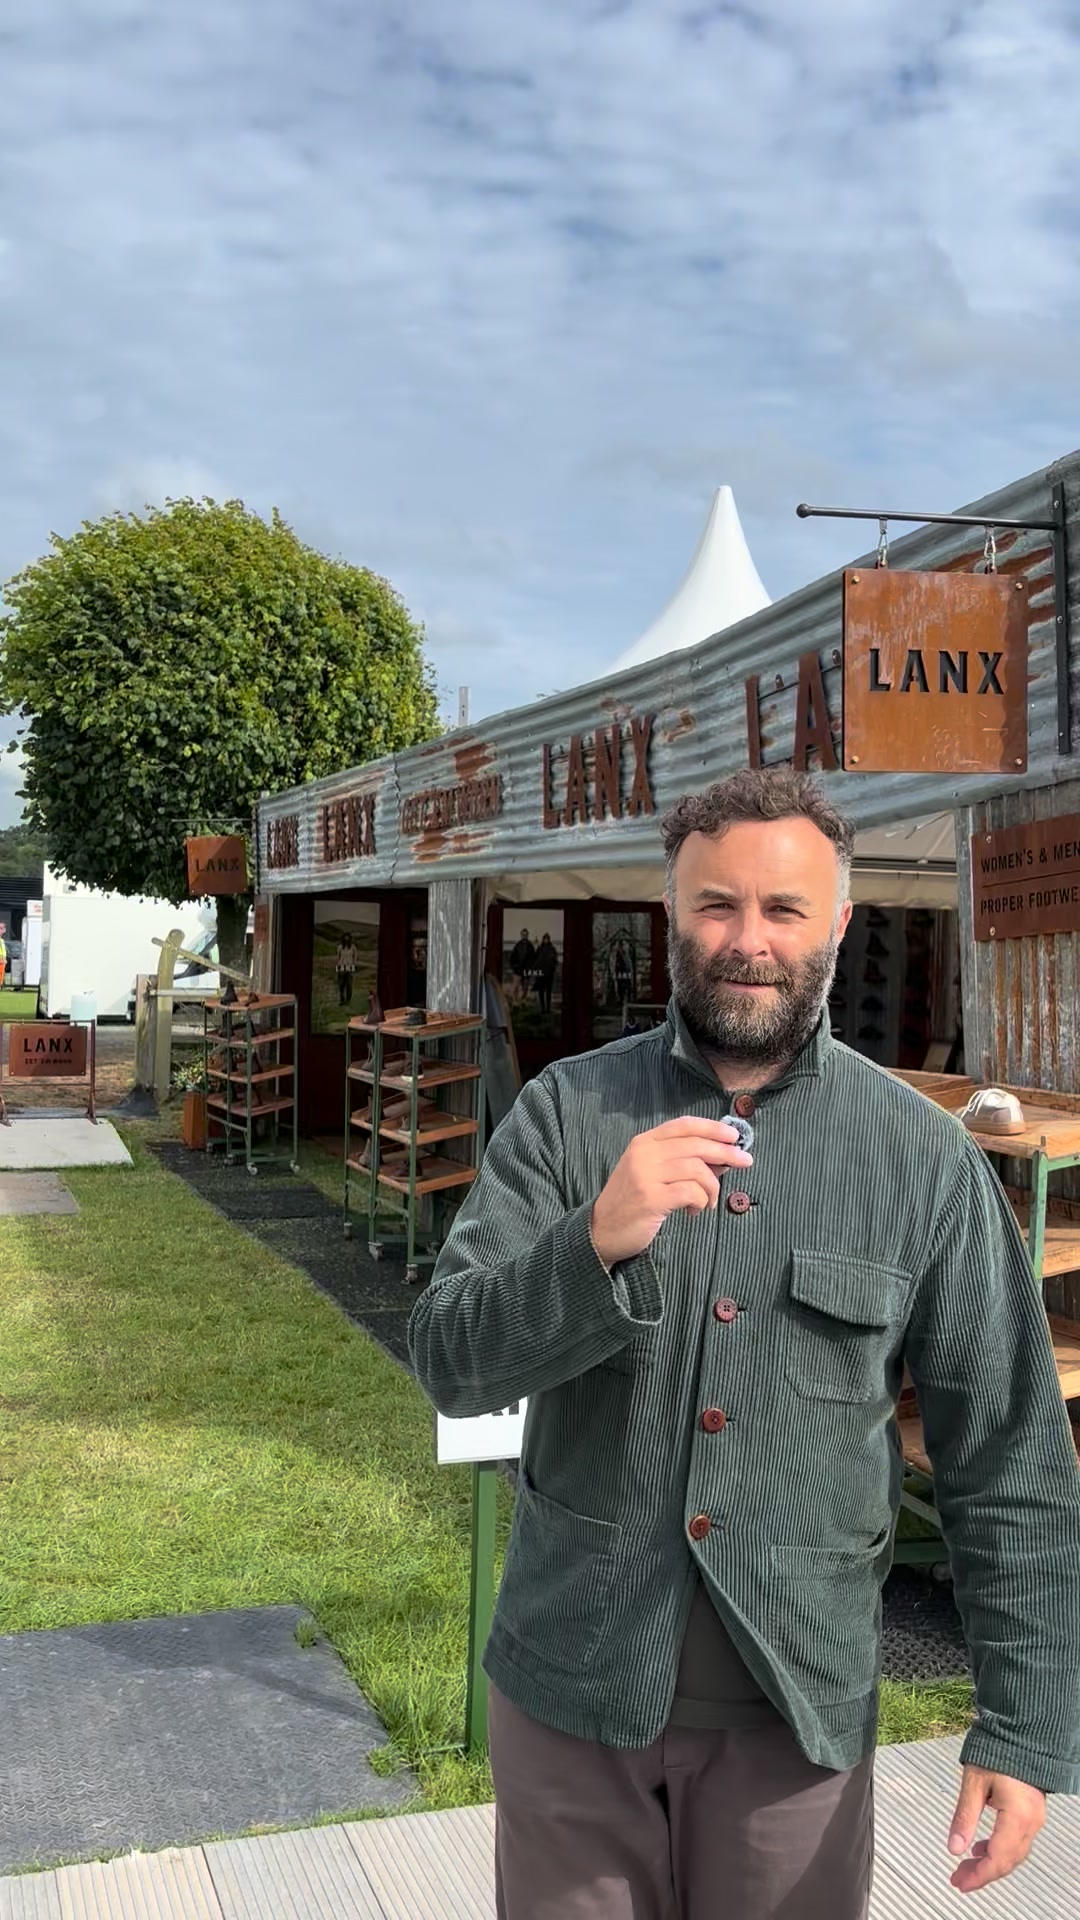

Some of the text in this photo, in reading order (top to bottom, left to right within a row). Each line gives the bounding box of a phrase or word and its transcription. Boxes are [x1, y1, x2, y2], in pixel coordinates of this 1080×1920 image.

[869, 648, 1004, 695] LANX
[745, 651, 838, 771] LA
[543, 714, 656, 829] LANX
[196, 859, 240, 872] LANX
[981, 840, 1080, 873] WOMEN'S & MEN
[981, 886, 1080, 916] PROPER FOOTWE
[24, 1038, 72, 1053] LANX
